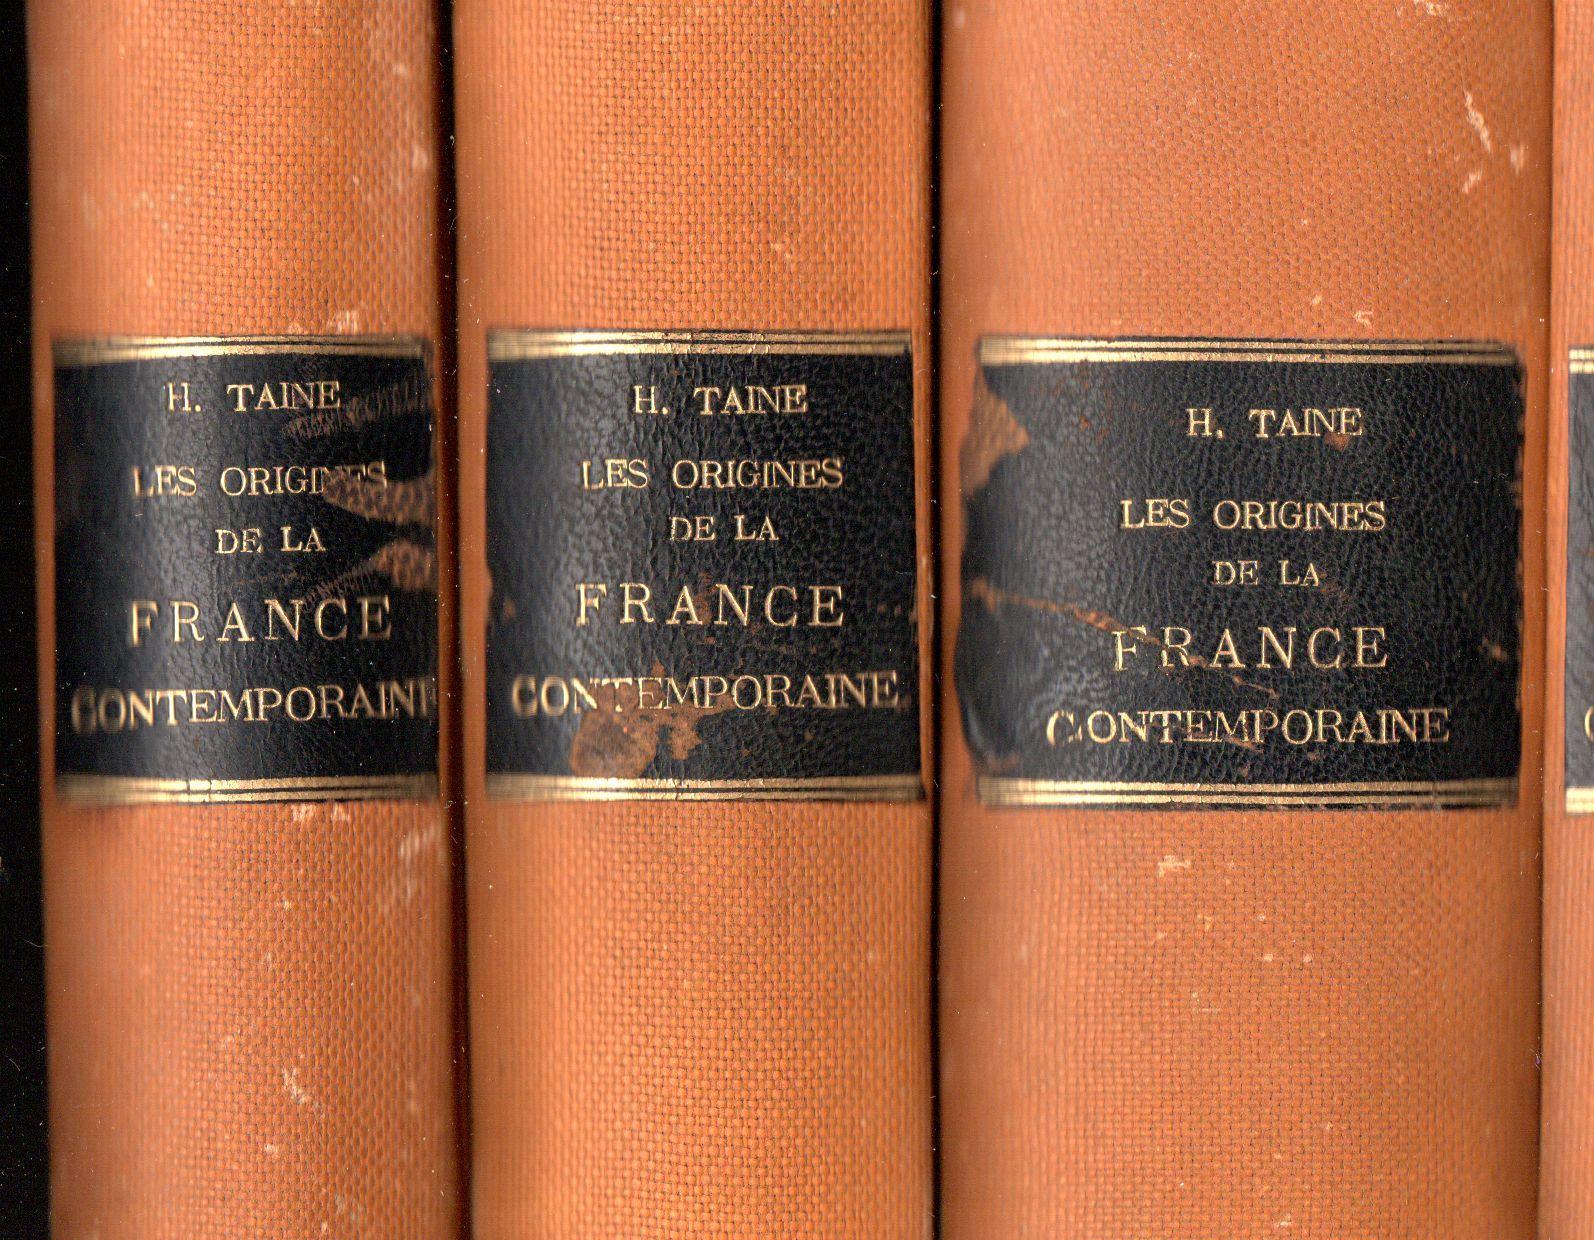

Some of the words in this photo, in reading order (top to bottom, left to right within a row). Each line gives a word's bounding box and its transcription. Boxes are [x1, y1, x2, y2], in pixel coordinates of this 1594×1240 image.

[166, 382, 201, 412] H.
[226, 381, 341, 412] TAINE
[633, 385, 668, 415] H.
[693, 383, 808, 415] TAINE
[1186, 408, 1223, 438] H.
[1249, 407, 1364, 438] TAINE
[132, 465, 197, 497] LES
[582, 459, 648, 489] LES
[672, 457, 844, 489] ORIGINES
[669, 516, 715, 541] DE
[734, 515, 779, 540] LA
[1121, 499, 1190, 529] LES
[1213, 500, 1386, 531] ORIGINES
[215, 527, 263, 554] DE
[280, 526, 326, 552] LA
[1212, 560, 1259, 586] DE
[1280, 560, 1320, 587] LA
[129, 594, 392, 648] FRANCE
[575, 583, 845, 627] FRANCE
[1112, 625, 1389, 671] FRANCE
[512, 670, 900, 716] CONTEMPORAINE
[1046, 707, 1451, 746] CONTEMPORAINE
